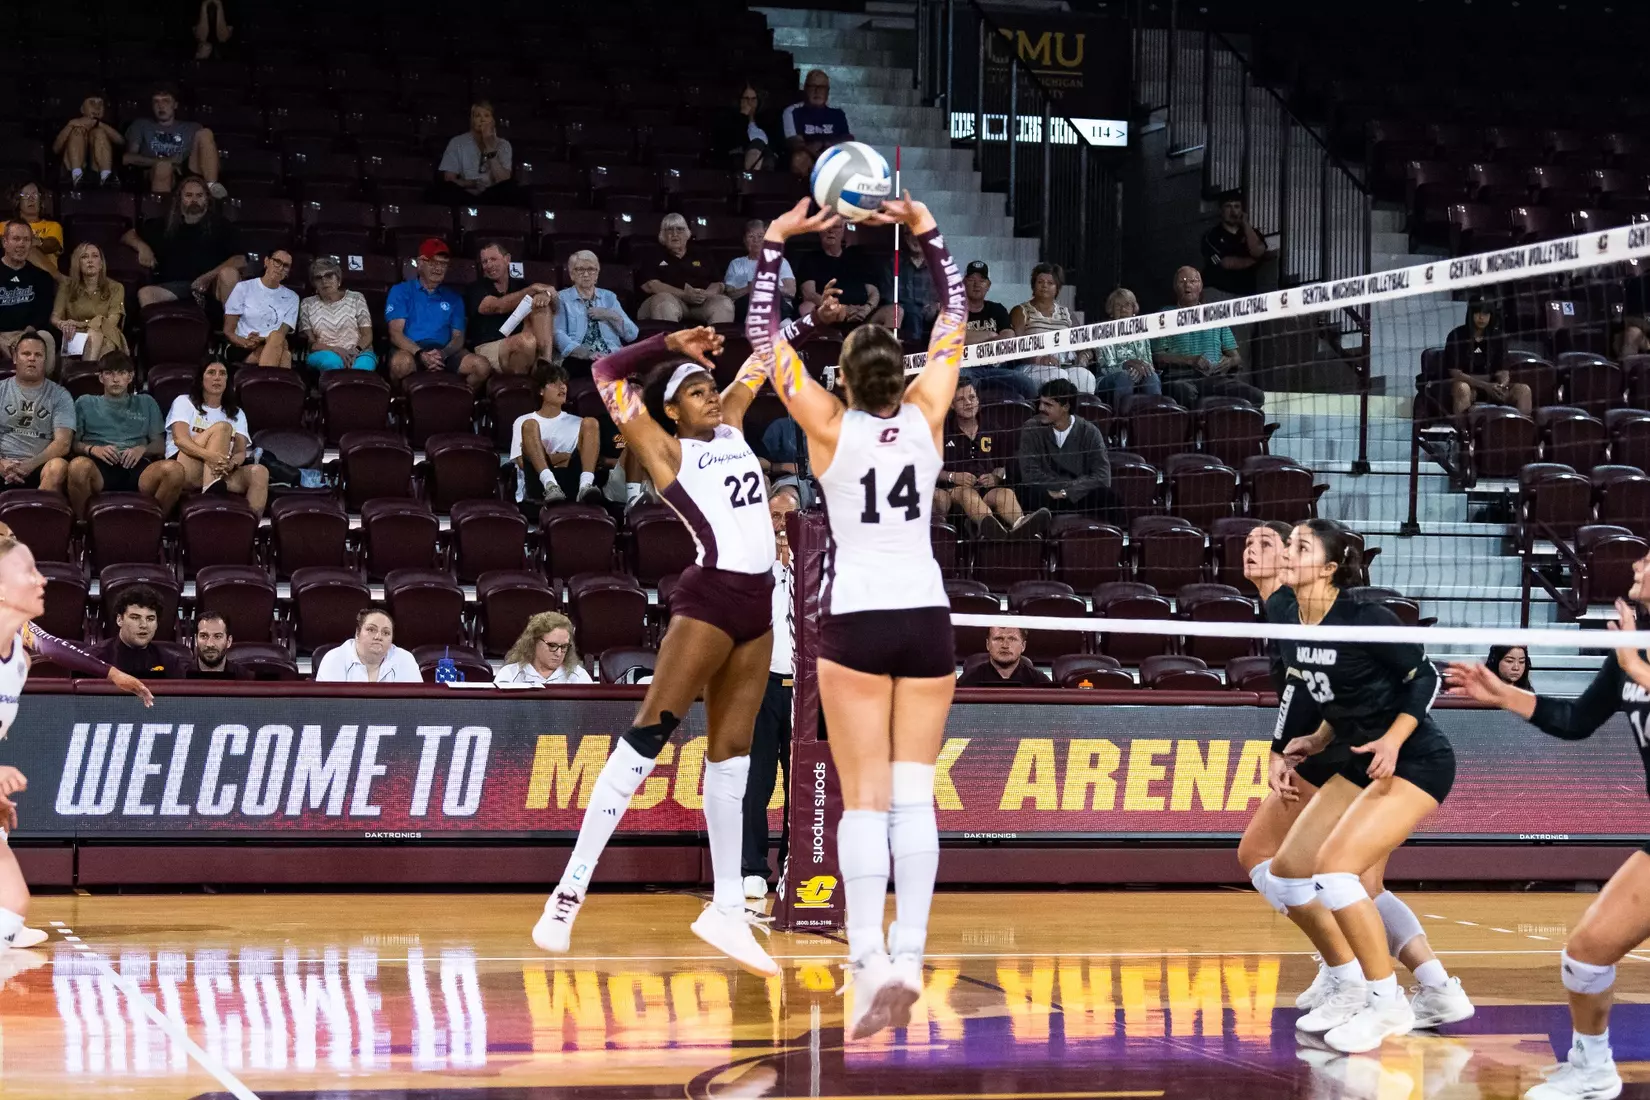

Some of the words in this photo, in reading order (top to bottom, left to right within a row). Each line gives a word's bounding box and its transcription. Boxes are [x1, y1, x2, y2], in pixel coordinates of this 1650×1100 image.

[1092, 126, 1110, 138] 114
[1450, 257, 1483, 280] CENTRAL
[1486, 249, 1525, 273] MICHIGAN
[1528, 235, 1579, 266] VOLLEYBALL
[1302, 285, 1330, 305] CENTRAL
[1332, 279, 1365, 300] MICHIGAN
[1368, 270, 1409, 295] VOLLEYBALL
[1176, 306, 1201, 327] CENTRAL
[1203, 302, 1231, 323] MICHIGAN
[1233, 295, 1268, 317] VOLLEYBALL
[976, 342, 995, 359] CENTRAL
[995, 339, 1017, 357] MICHIGAN
[1018, 334, 1045, 353] VOLLEYBALL
[1069, 326, 1090, 344] CENTRAL
[1092, 322, 1116, 340] MICHIGAN
[1117, 317, 1148, 337] VOLLEYBALL
[980, 436, 992, 453] C
[724, 471, 762, 509] 22
[860, 464, 921, 524] 14
[1301, 670, 1335, 703] 23
[55, 723, 398, 817] WELCOME
[409, 725, 493, 817] TO
[998, 738, 1273, 812] ARENA
[813, 762, 826, 807] sports
[365, 831, 422, 839] DAKTRONICS
[812, 809, 825, 863] imports
